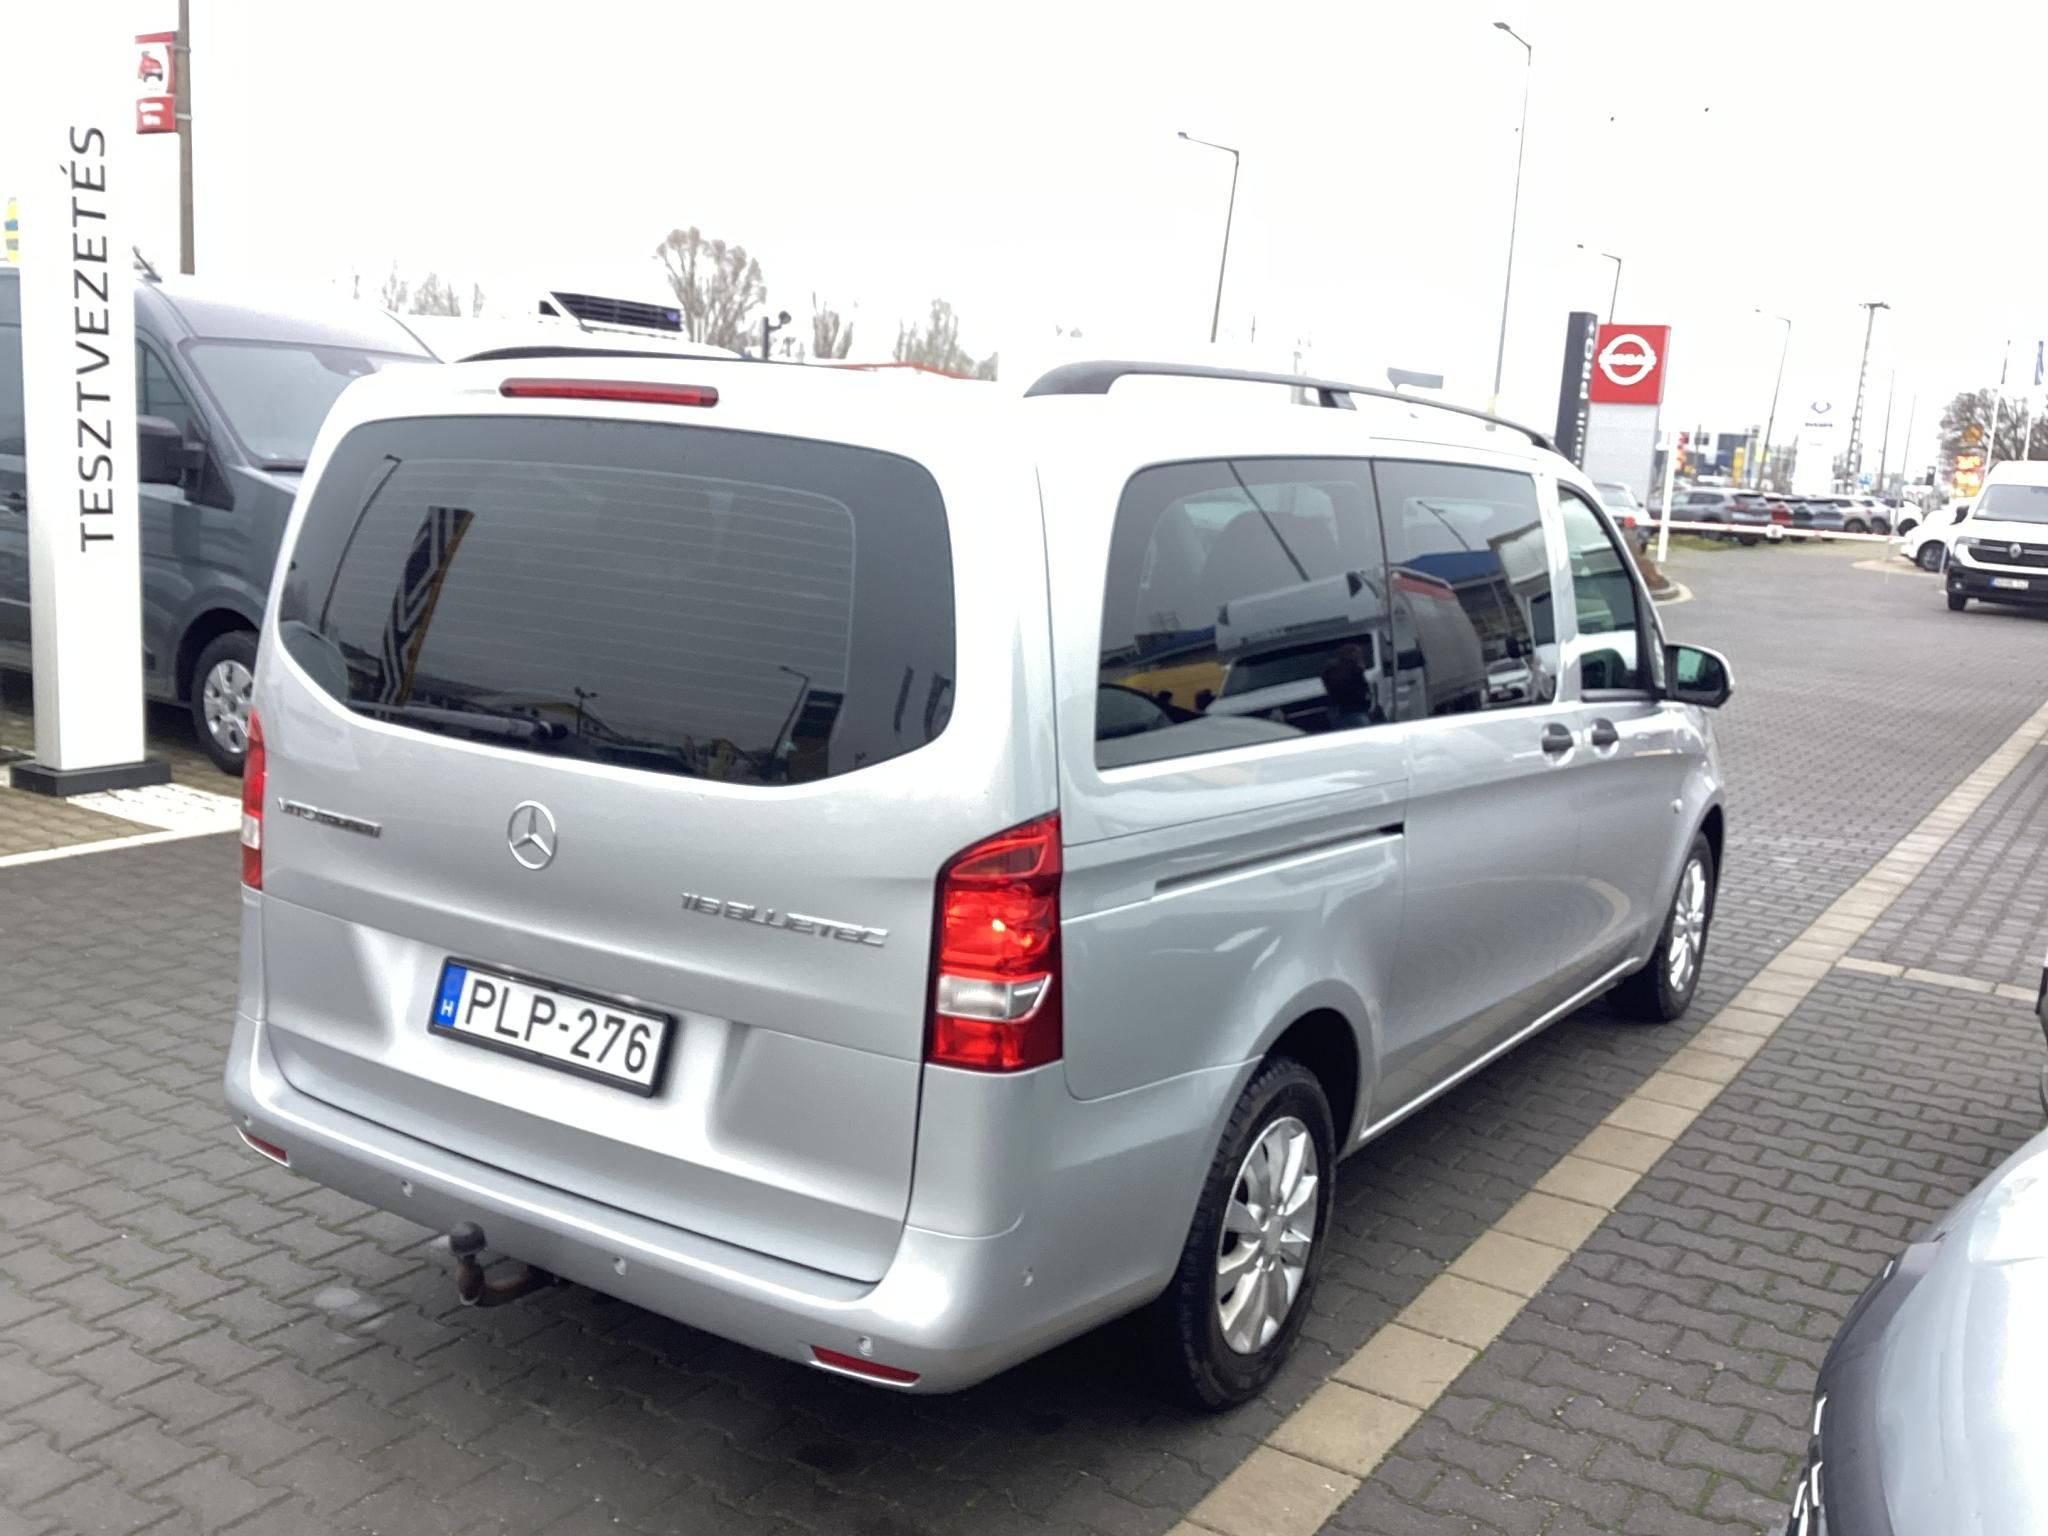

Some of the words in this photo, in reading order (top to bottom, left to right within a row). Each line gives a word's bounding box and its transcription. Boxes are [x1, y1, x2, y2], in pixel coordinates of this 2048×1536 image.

[60, 125, 114, 552] TESZTVEZETÉS
[440, 999, 454, 1017] H
[464, 978, 652, 1074] PLP-276
